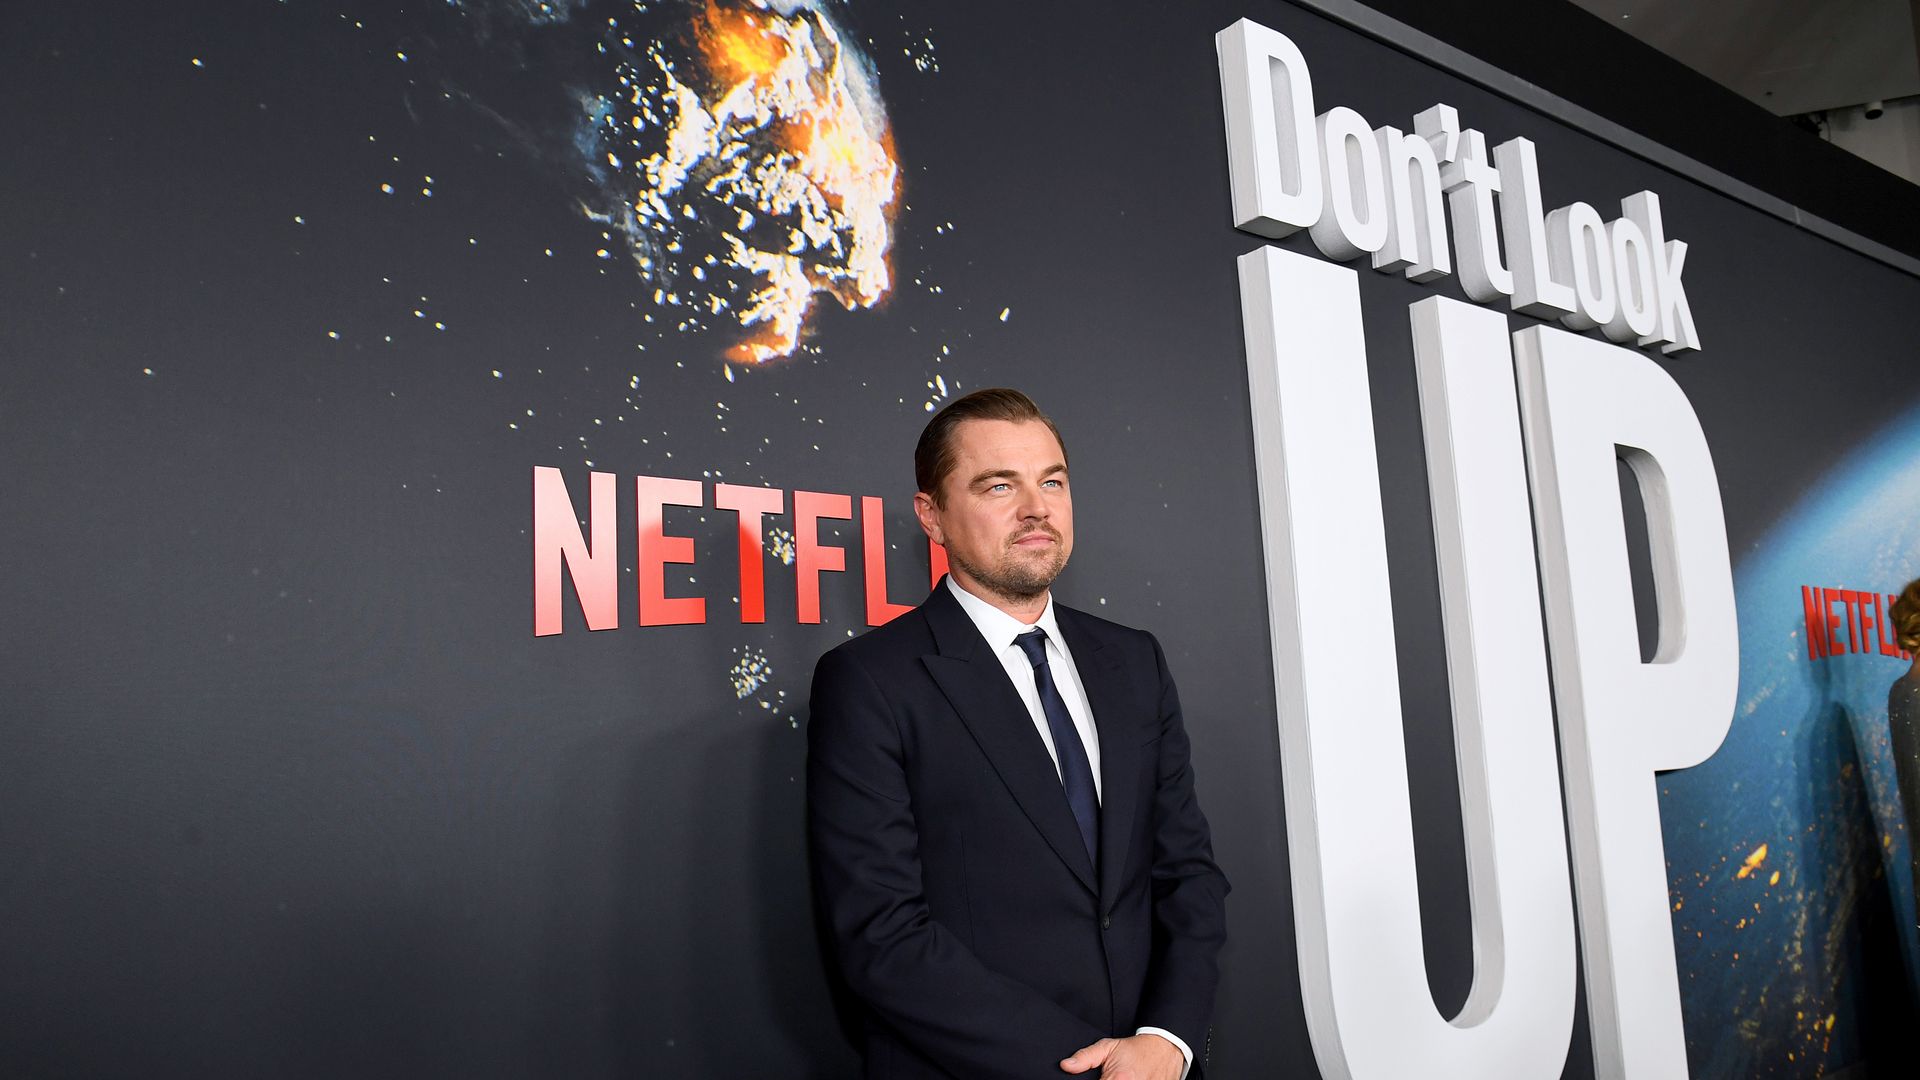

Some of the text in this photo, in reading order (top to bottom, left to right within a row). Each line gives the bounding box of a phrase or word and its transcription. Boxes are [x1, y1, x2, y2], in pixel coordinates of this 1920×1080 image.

[1215, 17, 1701, 354] Don't Look
[1237, 245, 1740, 1080] UP
[1801, 584, 1915, 661] NETFL
